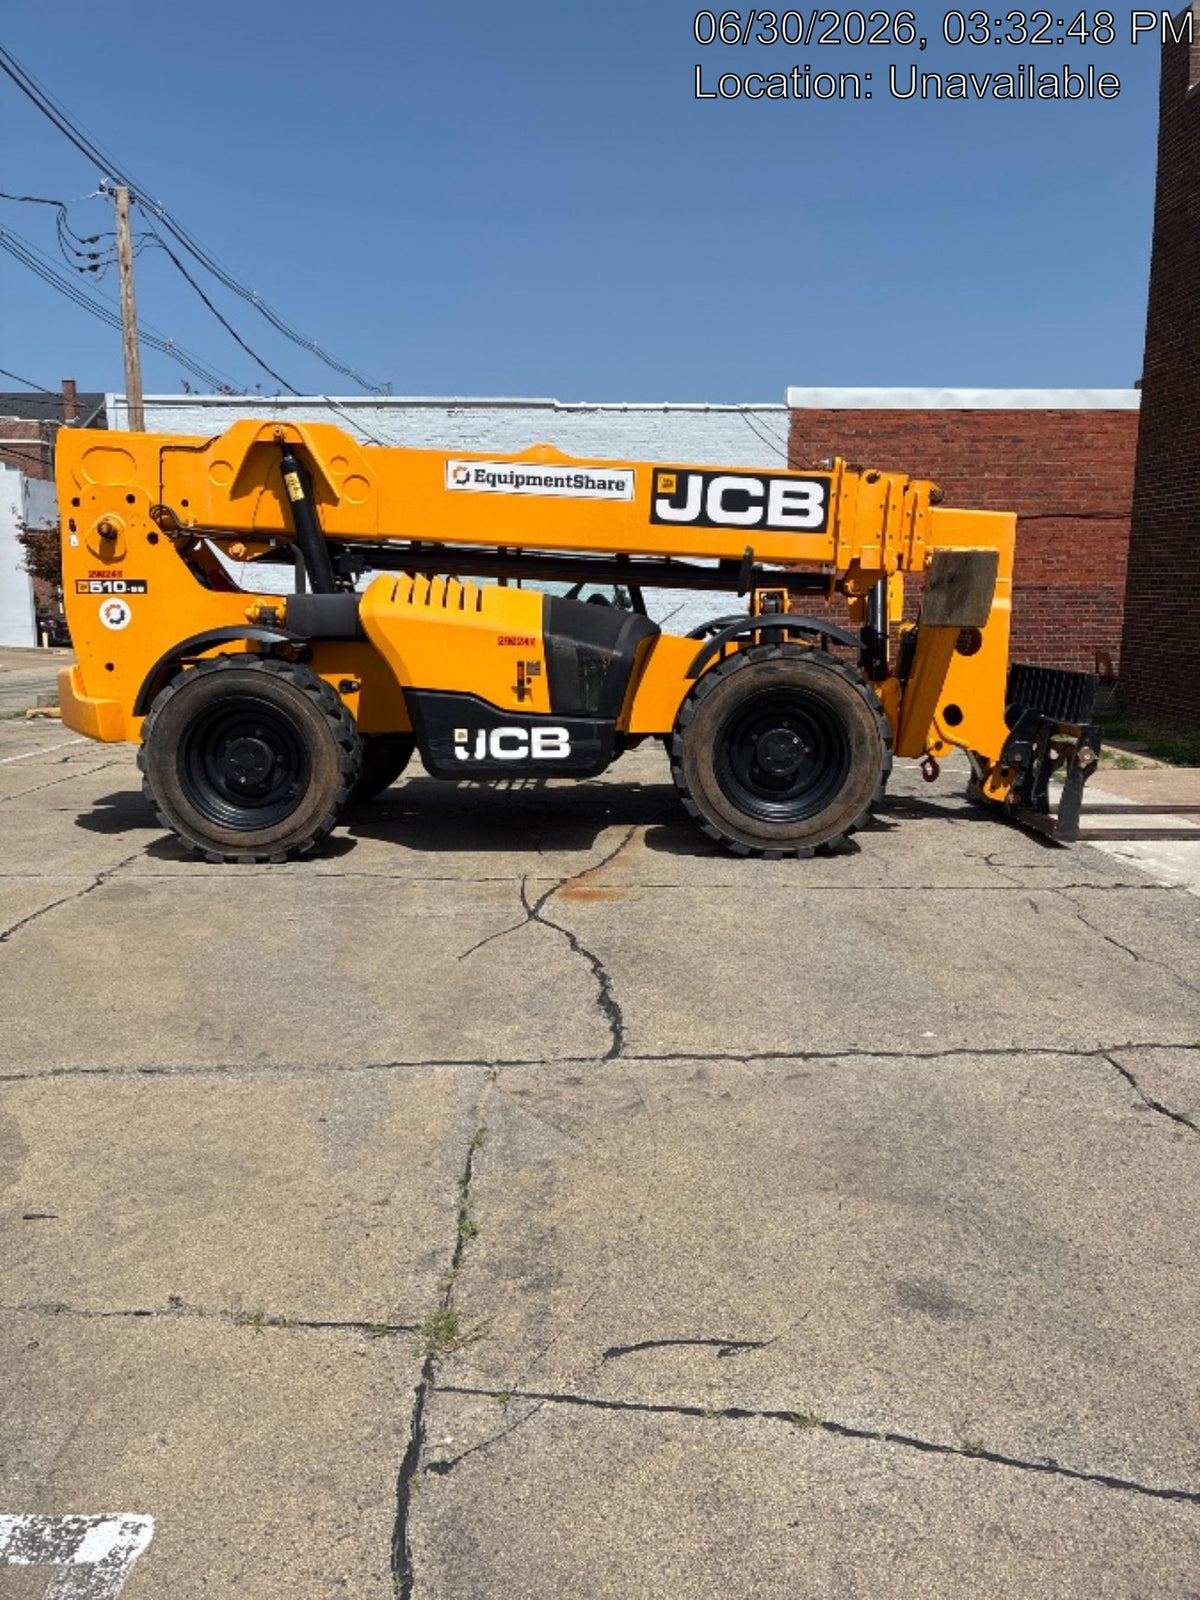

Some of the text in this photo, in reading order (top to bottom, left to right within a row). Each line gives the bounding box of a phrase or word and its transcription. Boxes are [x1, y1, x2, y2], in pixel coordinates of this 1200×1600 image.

[474, 468, 626, 491] EquipmentShare
[655, 474, 825, 529] JCB
[454, 726, 572, 760] JCB
